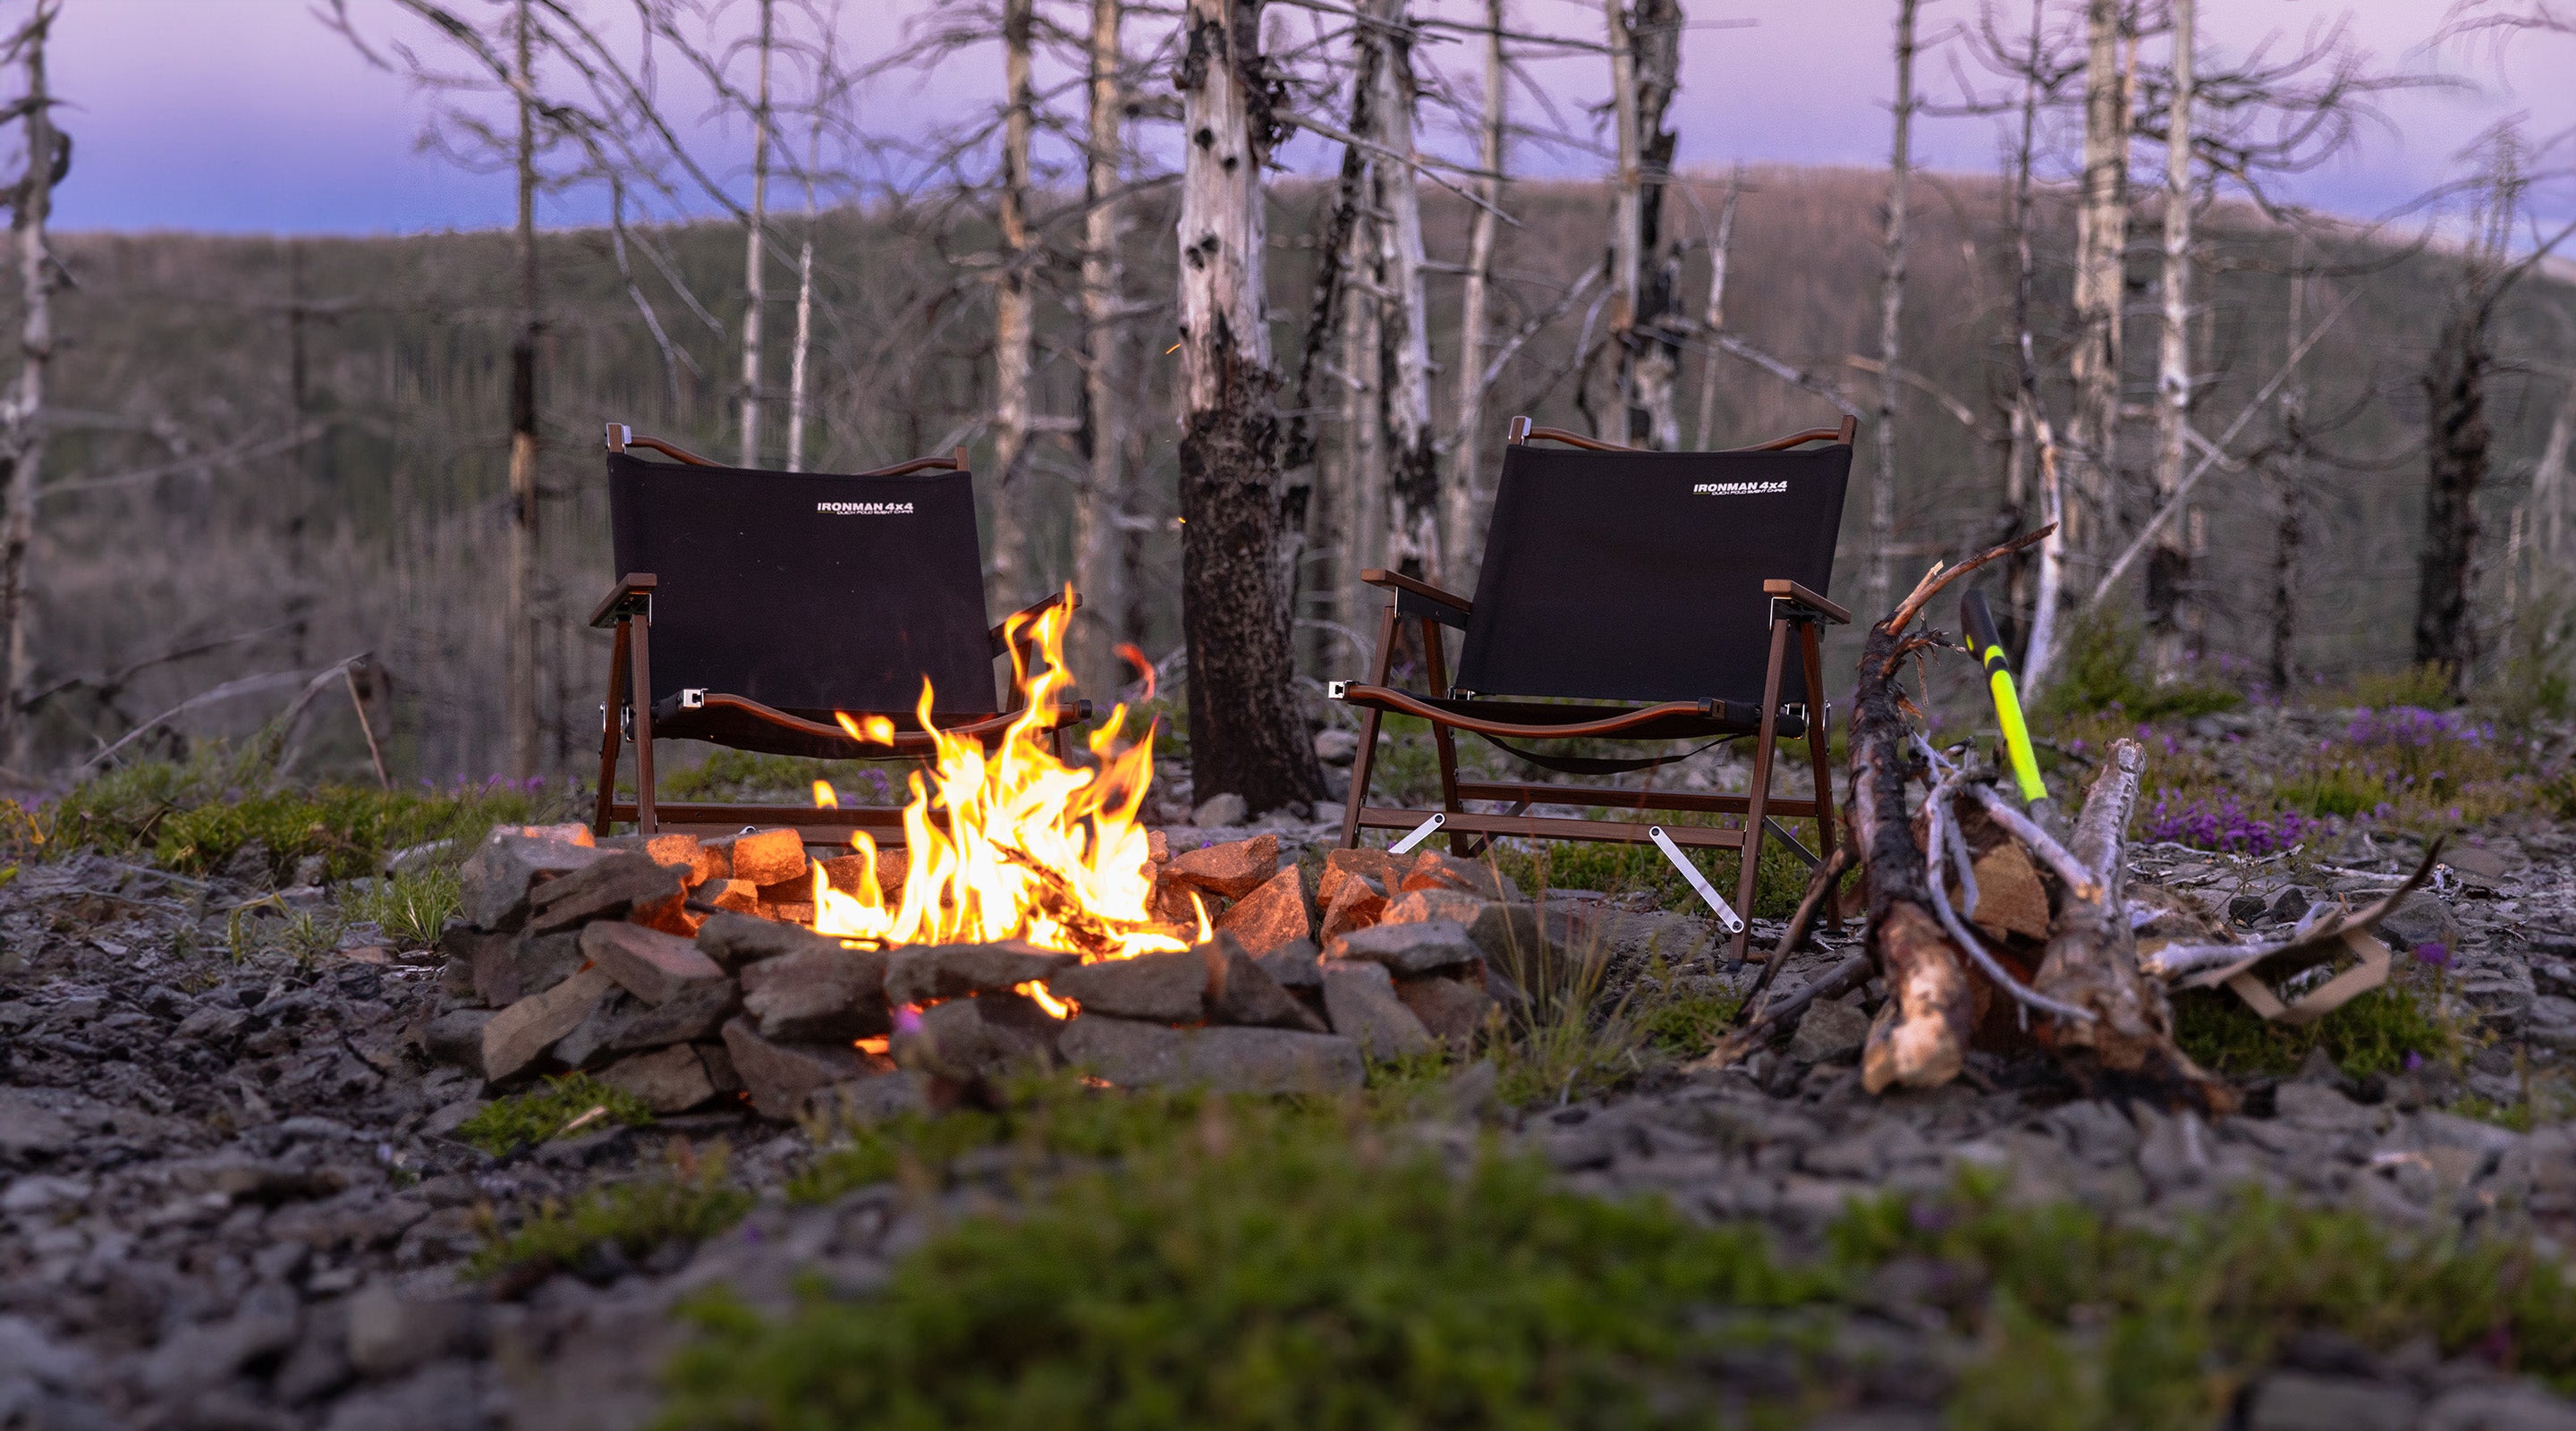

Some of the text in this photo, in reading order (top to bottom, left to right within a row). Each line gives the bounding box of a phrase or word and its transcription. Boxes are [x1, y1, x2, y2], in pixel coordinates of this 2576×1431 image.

[1693, 481, 1787, 492] IRONMAN 4x4
[818, 503, 914, 511] IRONMAN 4x4
